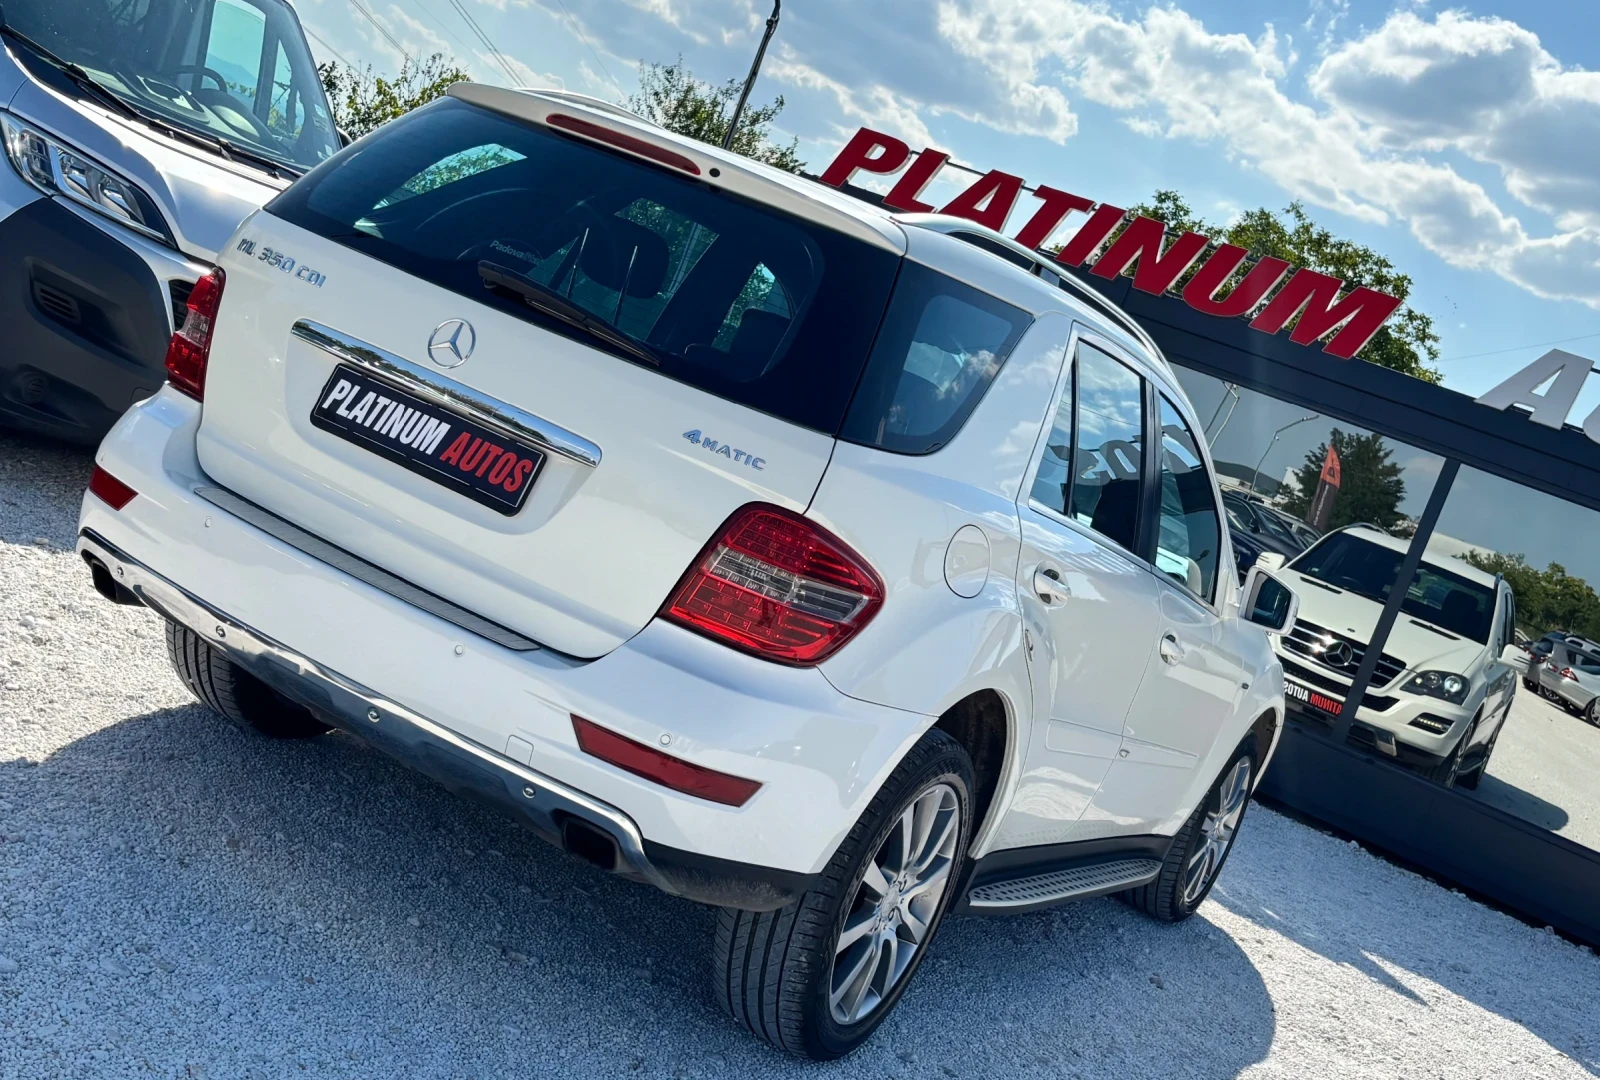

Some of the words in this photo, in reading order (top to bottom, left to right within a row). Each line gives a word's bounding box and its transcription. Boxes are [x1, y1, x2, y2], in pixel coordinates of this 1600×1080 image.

[237, 238, 256, 257] ML
[258, 246, 296, 273] 350
[295, 265, 327, 288] CDI
[820, 126, 1401, 360] PLATINUM
[1473, 348, 1600, 446] A
[322, 378, 451, 455] PLATINUM
[440, 431, 533, 493] AUTOS
[682, 429, 766, 471] 4MATIC
